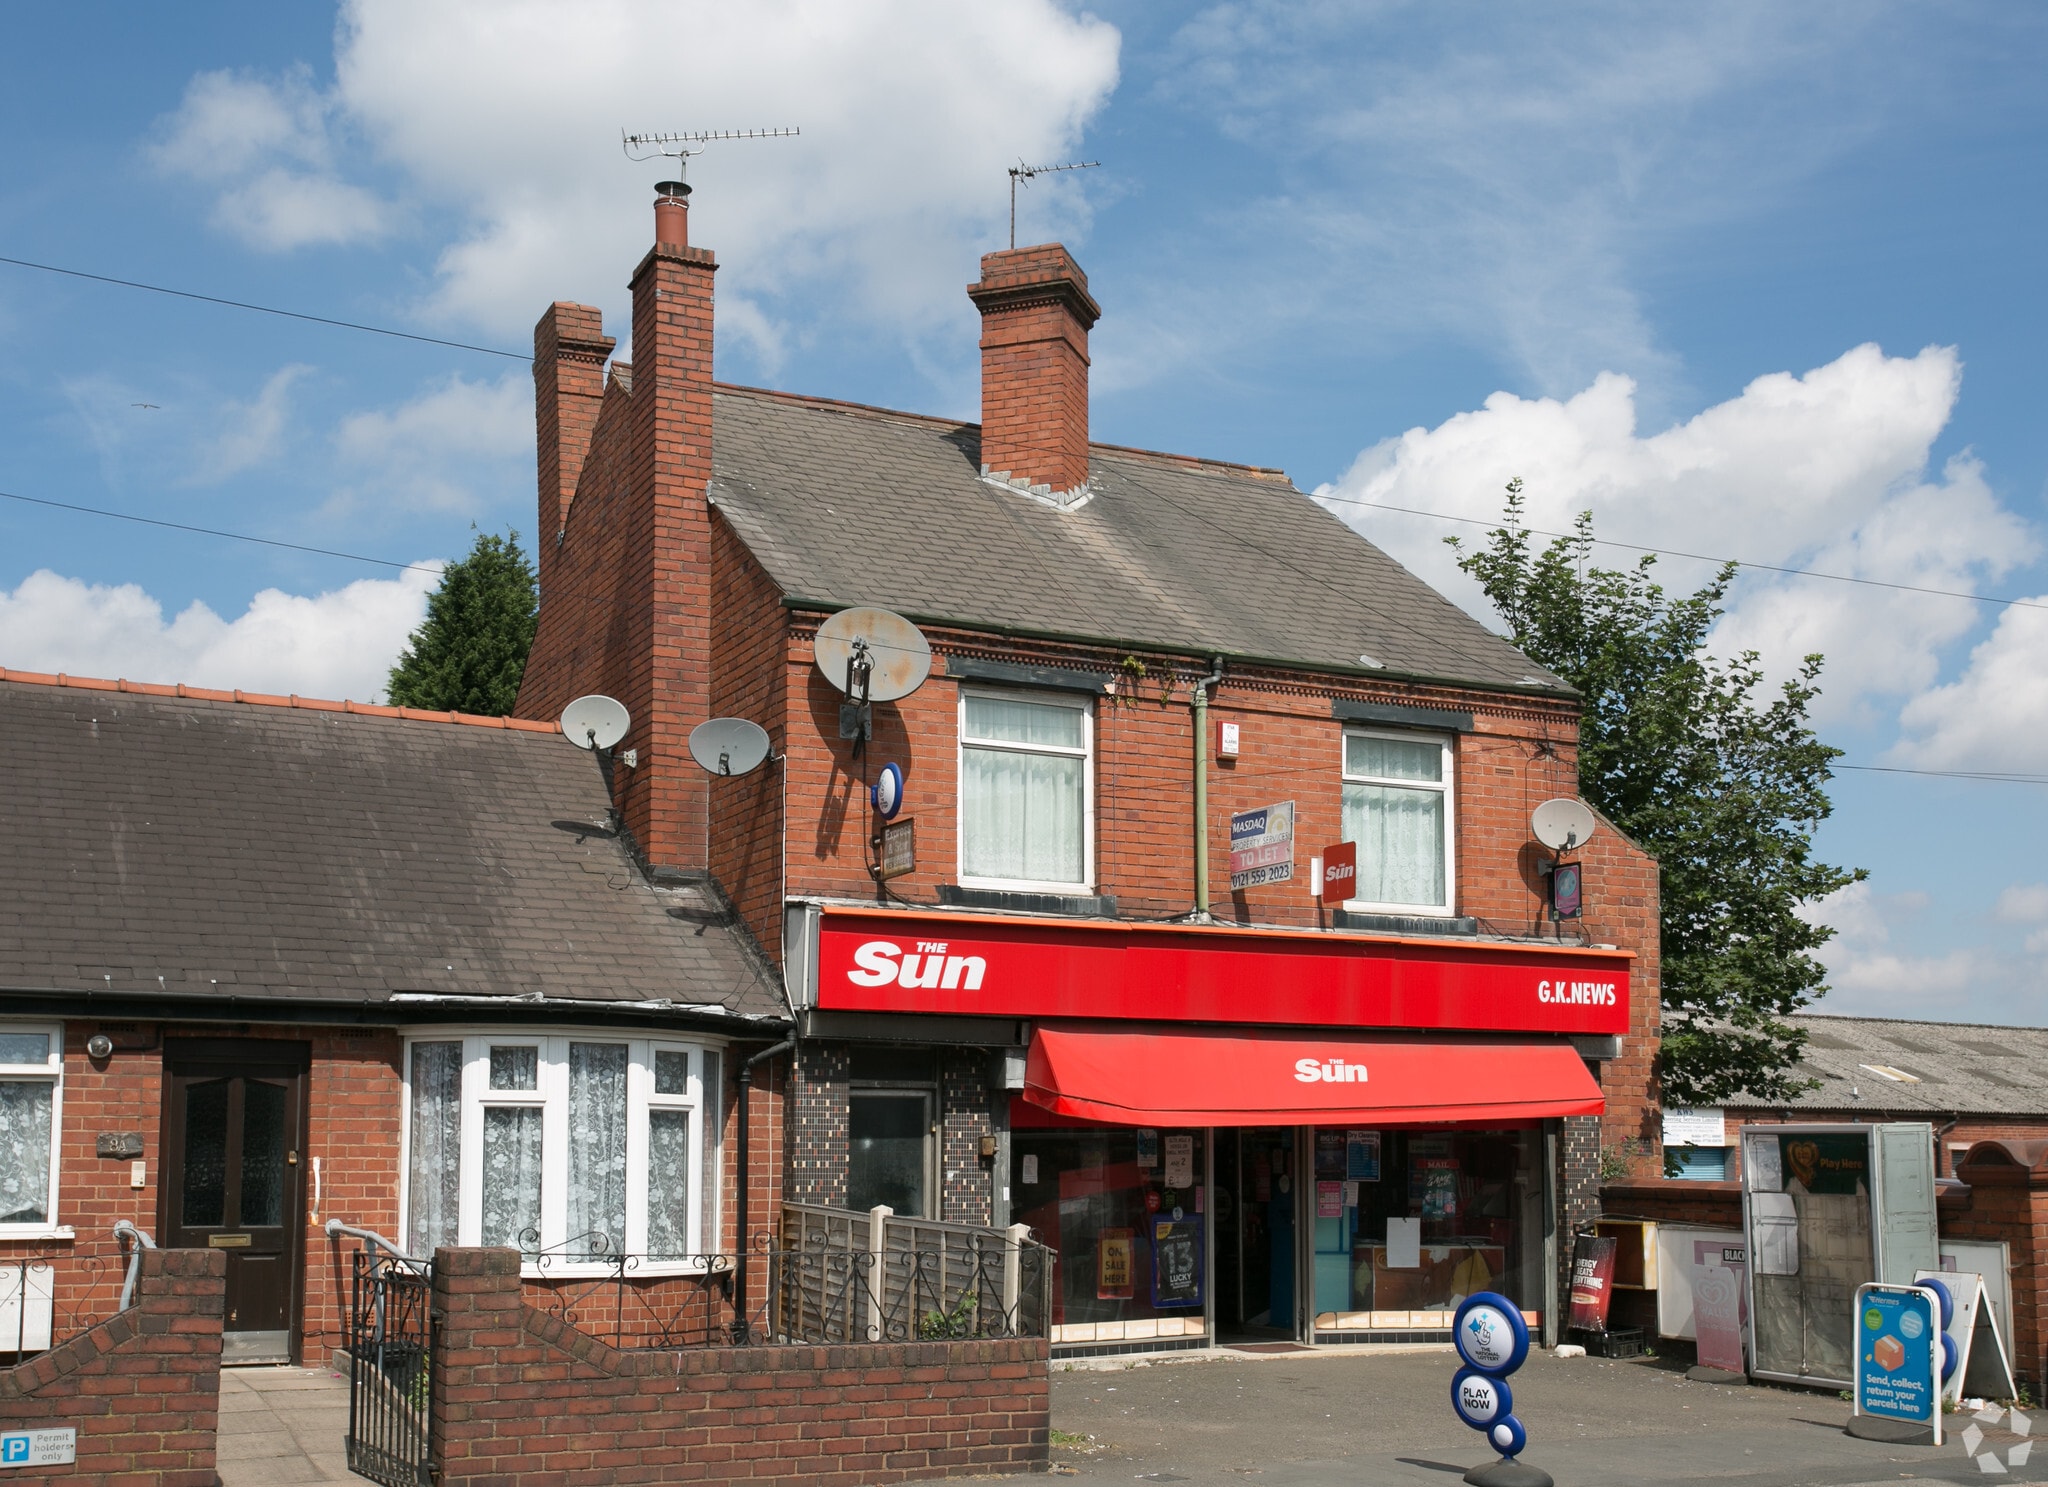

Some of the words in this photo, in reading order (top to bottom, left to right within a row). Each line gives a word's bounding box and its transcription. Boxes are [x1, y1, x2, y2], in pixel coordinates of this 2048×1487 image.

[1232, 817, 1265, 834] MASDAQ
[1233, 838, 1260, 851] PROPERTY
[1263, 832, 1289, 845] SERVICES
[1240, 851, 1254, 867] TO
[1258, 846, 1278, 862] LET
[1232, 872, 1249, 887] 0121
[1251, 869, 1266, 884] 559
[1269, 864, 1289, 880] 2023
[1325, 865, 1353, 882] Sun
[917, 942, 948, 954] THE
[847, 941, 987, 990] Sun
[1538, 980, 1616, 1006] G.K.NEWS
[1294, 1058, 1368, 1083] Sun
[1181, 1158, 1186, 1166] 2
[1820, 1158, 1840, 1170] Play
[1841, 1158, 1862, 1168] Here
[1107, 1247, 1122, 1257] ON
[1163, 1241, 1193, 1274] 13
[1105, 1261, 1125, 1270] SALE
[1104, 1274, 1126, 1284] HERE
[1170, 1273, 1191, 1282] LUCKY
[1866, 1374, 1890, 1387] Send,
[1891, 1378, 1924, 1392] collect,
[1463, 1387, 1489, 1398] PLAY
[1866, 1387, 1893, 1397] return
[1895, 1391, 1916, 1400] your
[1464, 1398, 1490, 1409] NOW
[1866, 1398, 1898, 1409] parcels
[1899, 1401, 1920, 1413] here
[37, 1433, 69, 1441] Permit
[34, 1443, 71, 1452] holders
[41, 1452, 63, 1460] only
